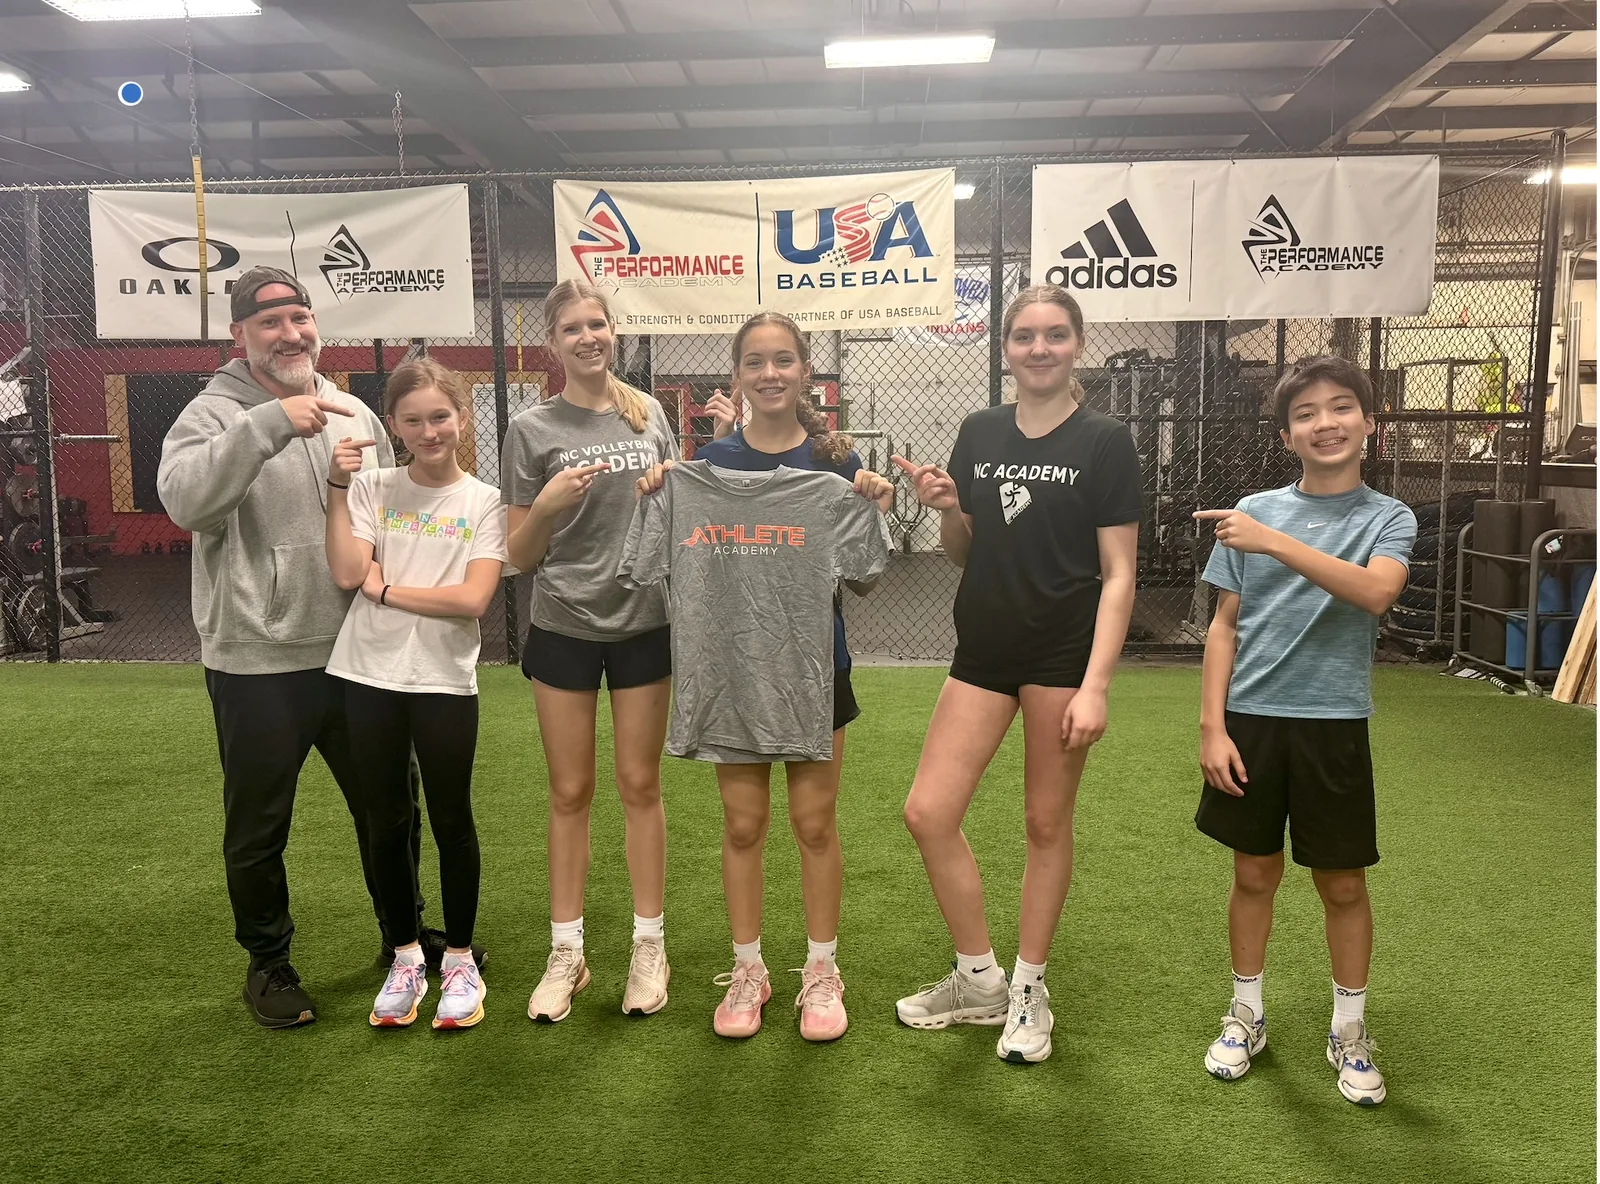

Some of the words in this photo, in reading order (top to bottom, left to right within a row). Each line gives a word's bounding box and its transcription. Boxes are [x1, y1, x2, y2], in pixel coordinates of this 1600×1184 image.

[772, 200, 934, 266] USA
[1260, 248, 1268, 265] THE
[1268, 245, 1384, 264] PERFORMANCE
[594, 256, 602, 277] THE
[603, 254, 745, 278] PERFORMANCE
[1045, 257, 1178, 289] adidas
[1260, 262, 1383, 273] ACADEMY
[343, 268, 445, 287] PERFORMANCE
[597, 276, 745, 288] ACADEMY
[777, 267, 938, 290] BASEBALL
[337, 284, 445, 294] ACADEMY
[626, 314, 682, 325] STRENGTH
[686, 314, 694, 325] &
[787, 311, 835, 322] PARTNER
[840, 310, 854, 320] OF
[859, 309, 881, 319] USA
[886, 305, 942, 318] BASEBALL
[559, 449, 579, 463] NC
[973, 462, 991, 480] NC
[993, 463, 1081, 486] ACADEMY
[678, 524, 805, 547] ATHLETE
[713, 545, 779, 556] ACADEMY
